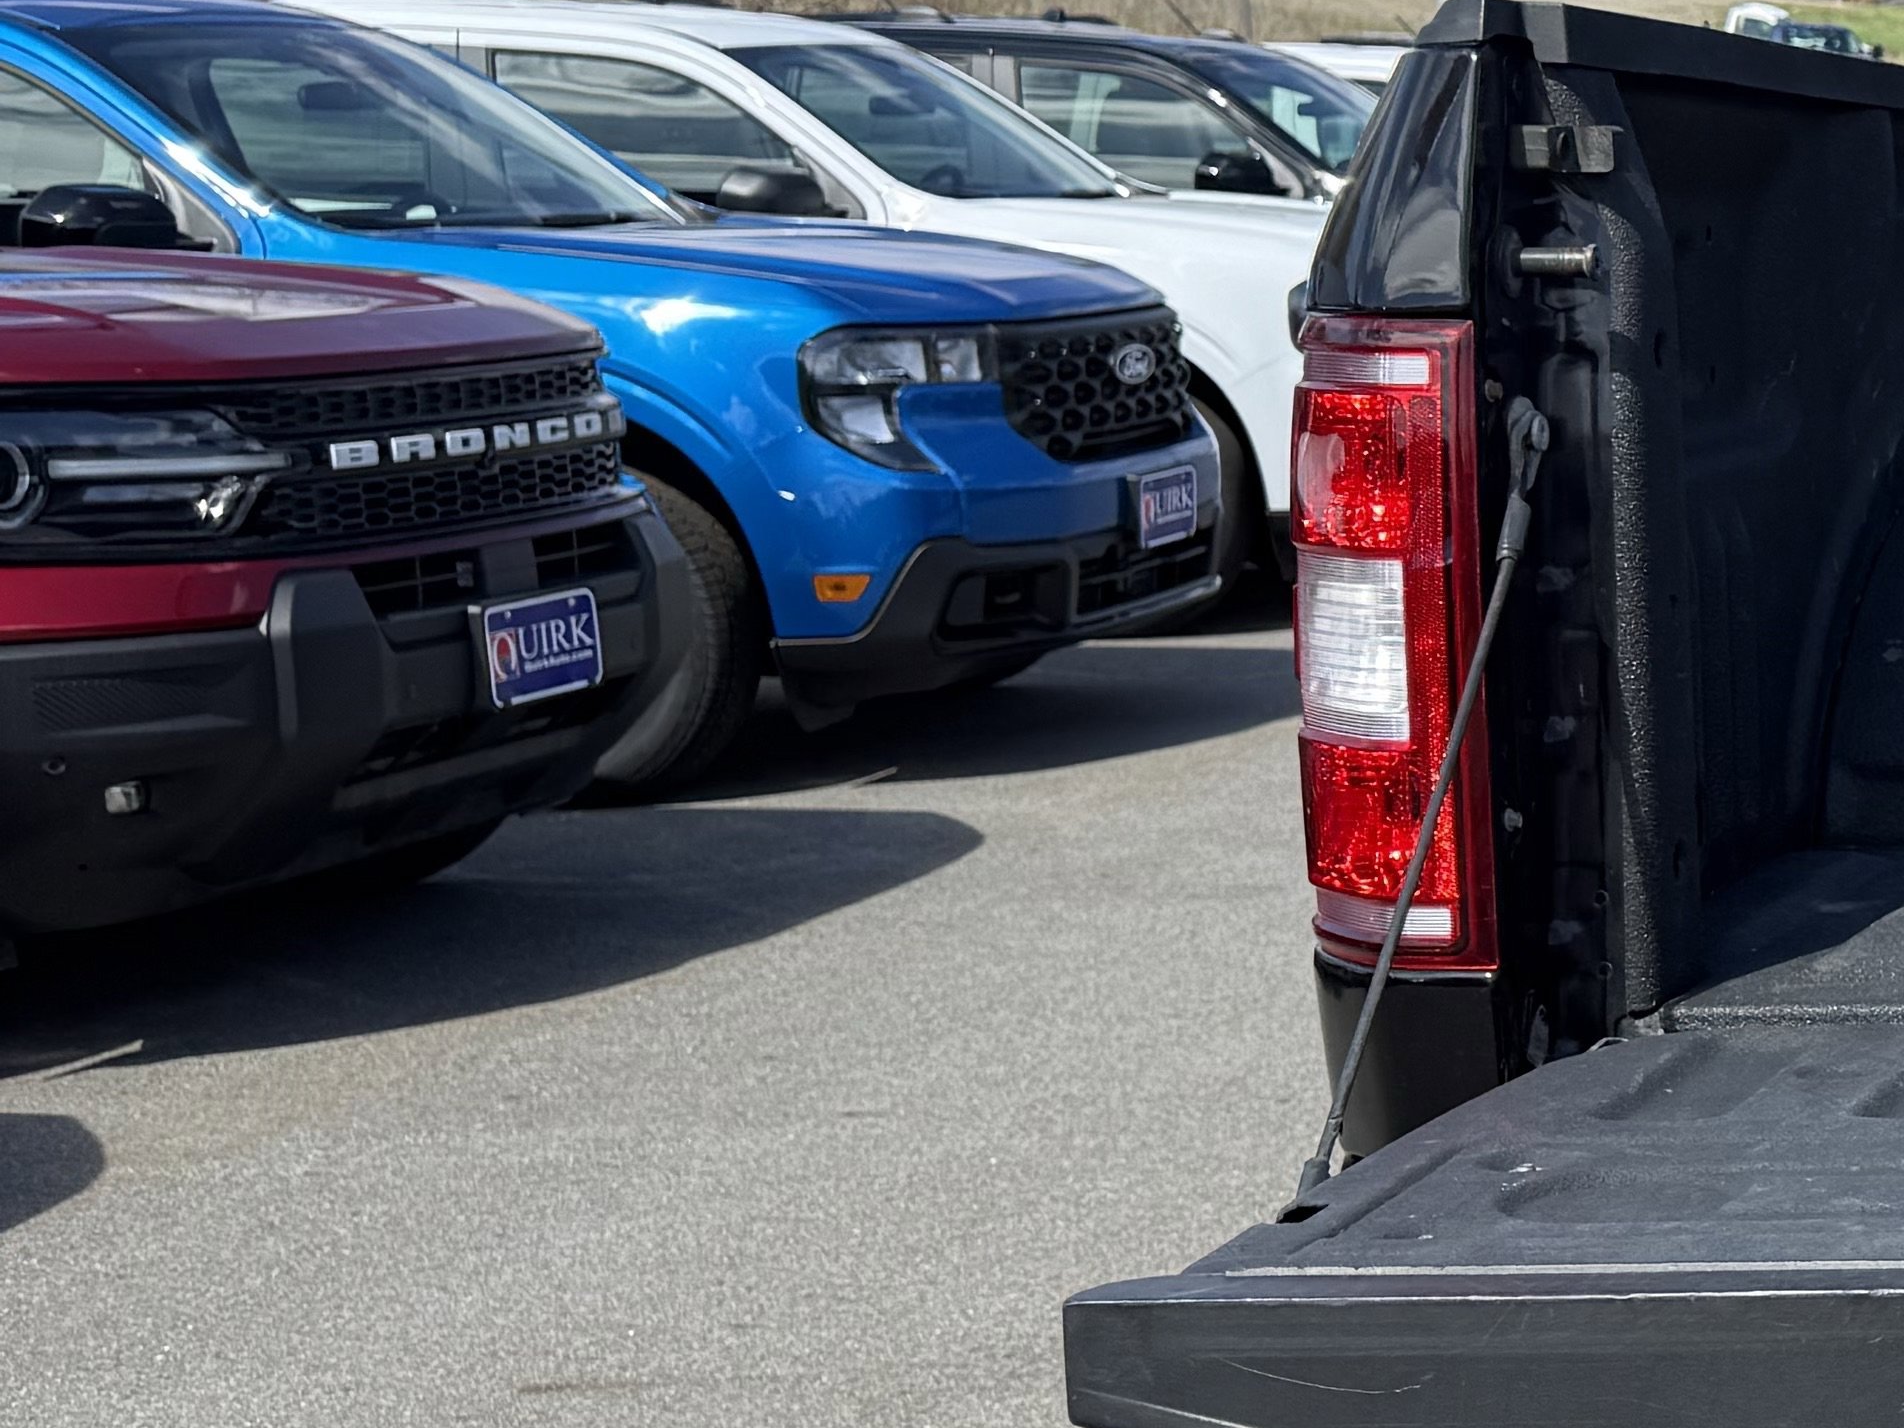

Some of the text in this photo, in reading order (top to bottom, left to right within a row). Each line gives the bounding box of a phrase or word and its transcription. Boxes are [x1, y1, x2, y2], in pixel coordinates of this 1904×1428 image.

[329, 412, 602, 470] BRONCO
[1143, 483, 1193, 525] QUIRK
[494, 613, 594, 680] QUIRK
